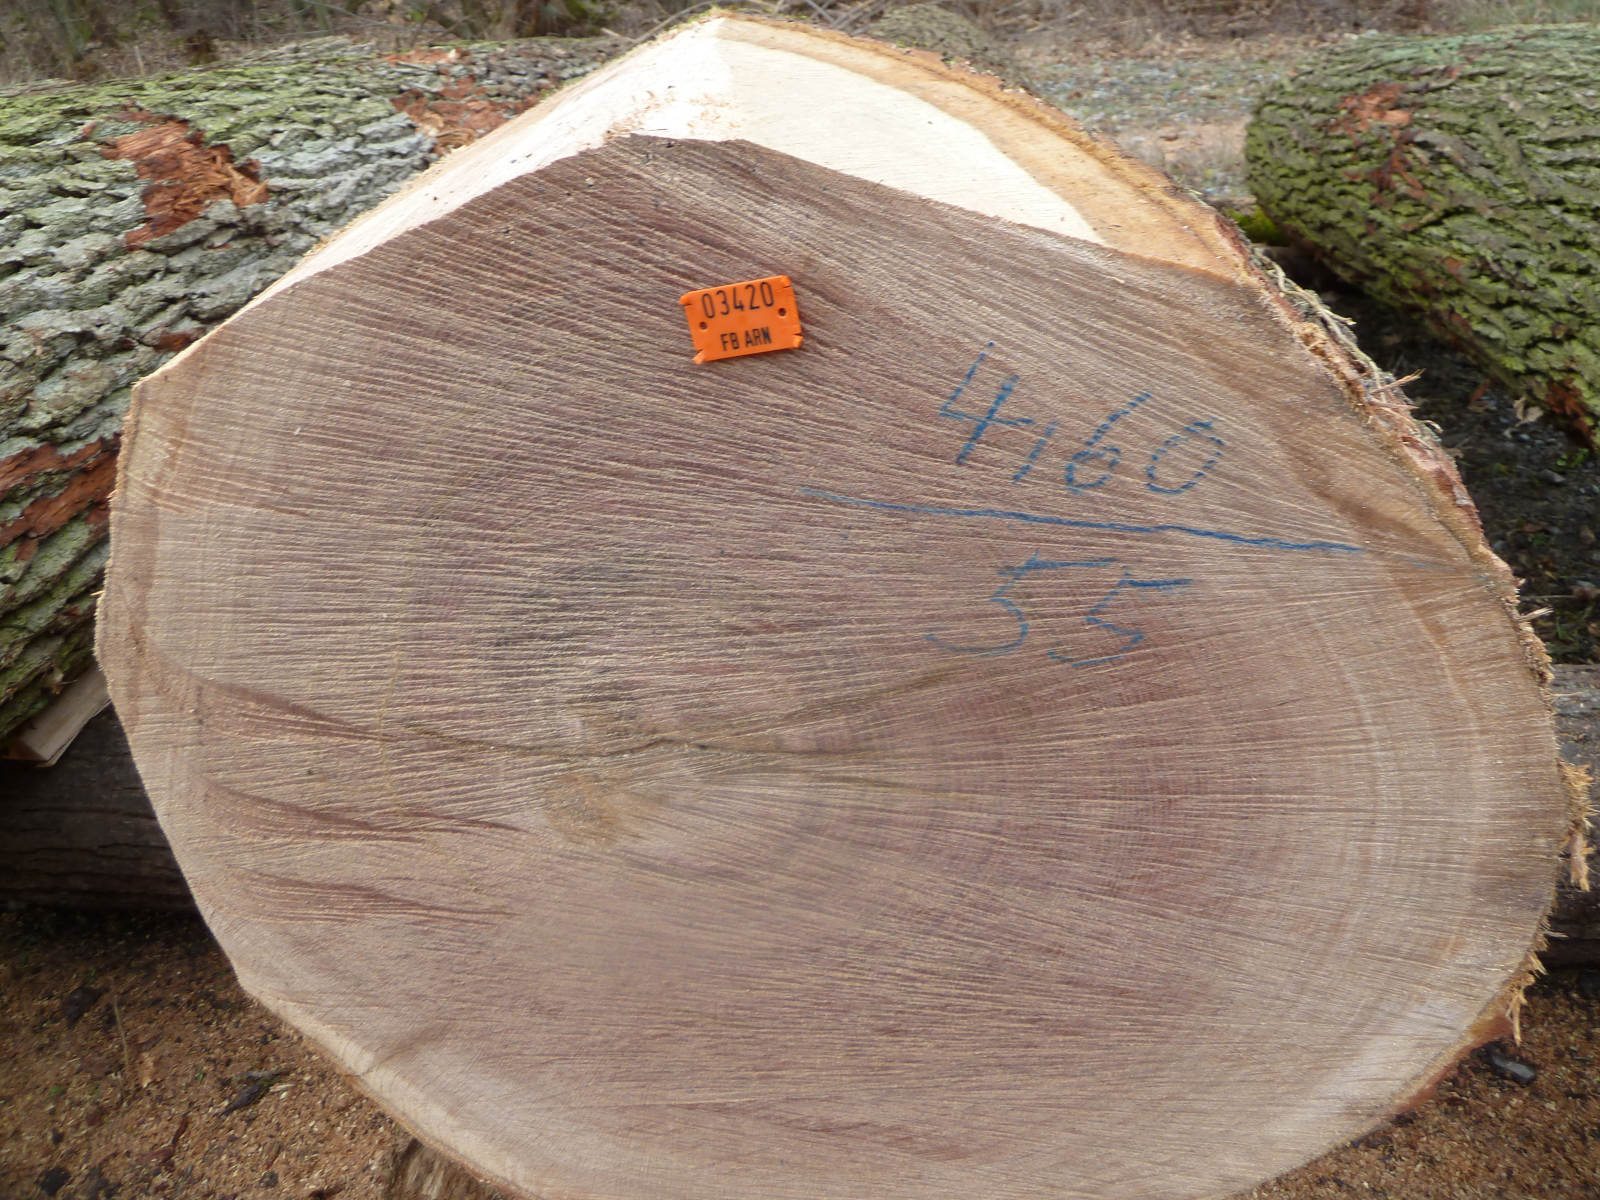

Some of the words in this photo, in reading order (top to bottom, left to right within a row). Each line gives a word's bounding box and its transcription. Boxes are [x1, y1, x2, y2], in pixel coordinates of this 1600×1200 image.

[701, 281, 775, 319] 03420
[720, 332, 740, 352] FB
[744, 327, 772, 348] ARN
